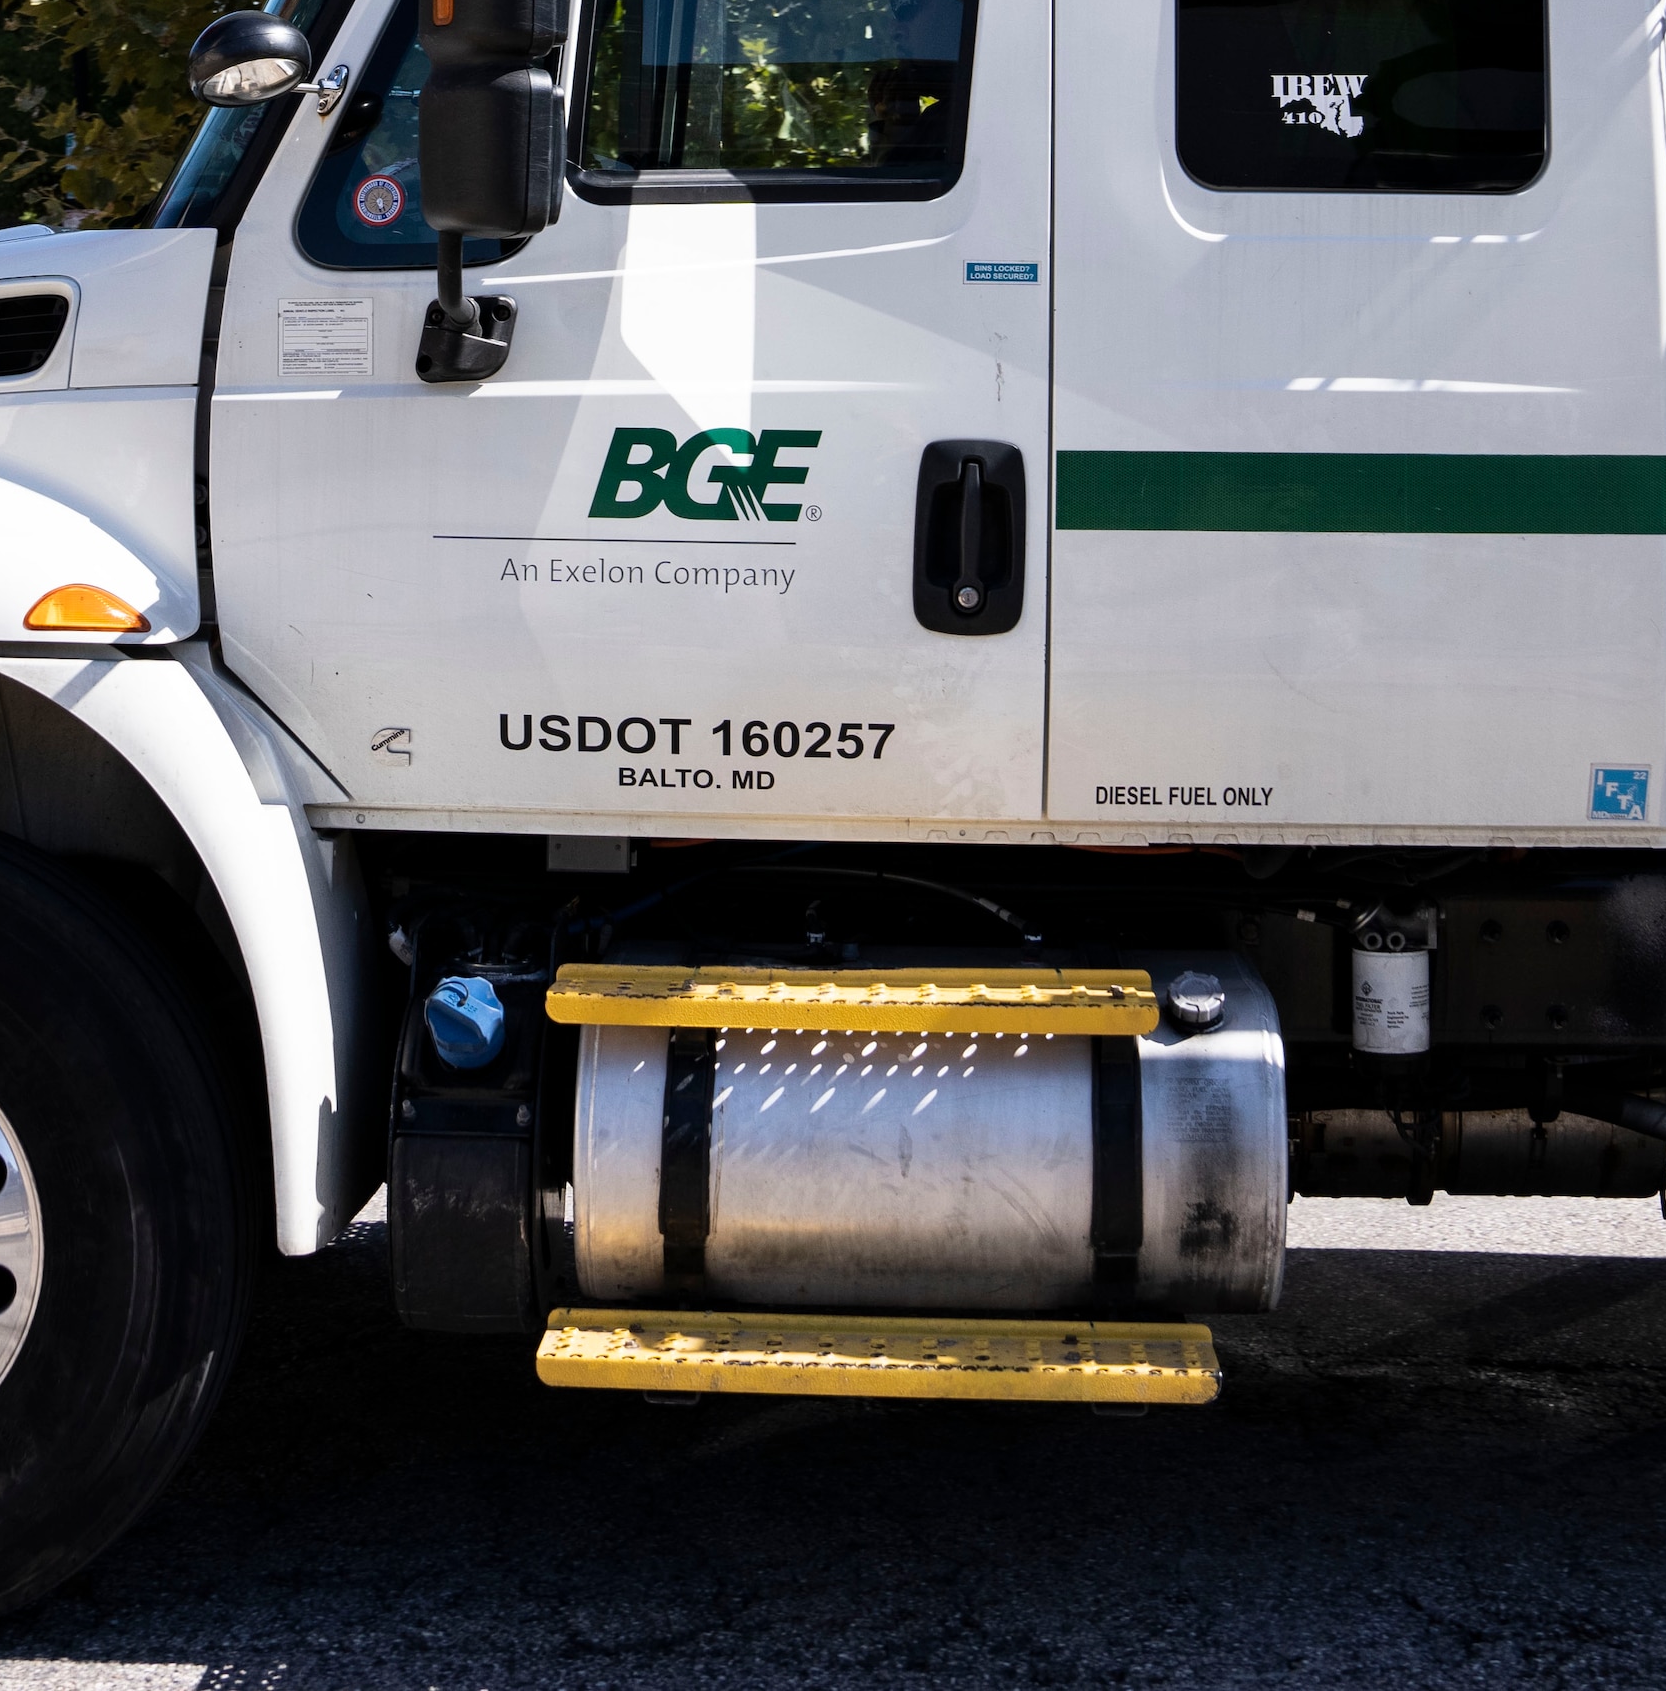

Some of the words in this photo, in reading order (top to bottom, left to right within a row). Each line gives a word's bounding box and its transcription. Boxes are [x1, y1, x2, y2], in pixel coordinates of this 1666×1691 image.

[1271, 74, 1368, 98] IBEW
[1281, 112, 1323, 124] 410
[588, 427, 822, 522] BGE
[500, 559, 538, 584] An
[551, 559, 644, 586] Exelon
[655, 561, 795, 594] Company
[371, 729, 405, 751] Cummins
[499, 714, 691, 756] USDOT
[712, 722, 896, 761] 160257
[618, 768, 722, 790] BALTO.
[731, 770, 775, 791] MD
[1633, 771, 1646, 780] 22
[1096, 786, 1162, 806] DIESEL
[1169, 787, 1217, 806] FUEL
[1223, 787, 1273, 807] ONLY
